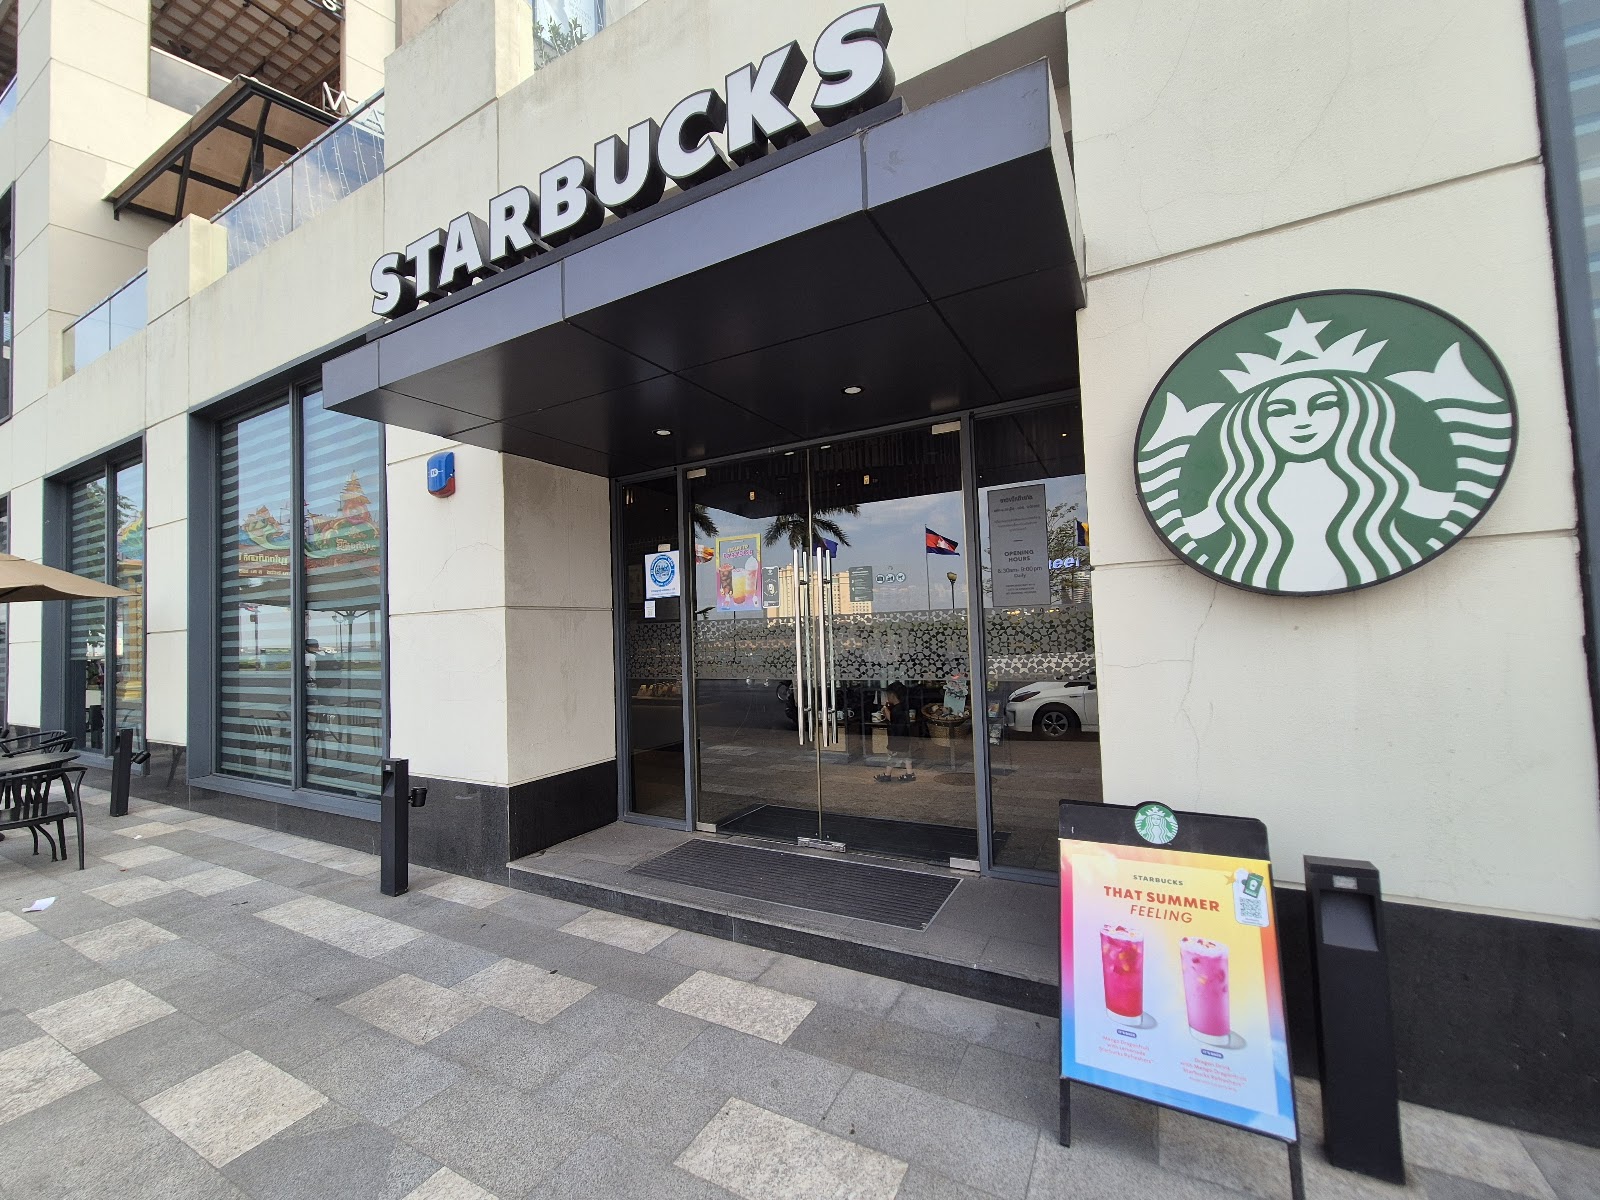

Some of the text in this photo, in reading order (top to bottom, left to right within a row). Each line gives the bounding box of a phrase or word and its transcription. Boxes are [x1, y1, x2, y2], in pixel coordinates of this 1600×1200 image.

[370, 2, 894, 320] STARBUCKS
[1004, 549, 1034, 557] OPENING
[1133, 874, 1184, 886] STARBUCKS
[1103, 885, 1220, 912] THAT SUMMER
[1130, 904, 1193, 924] FEELING
